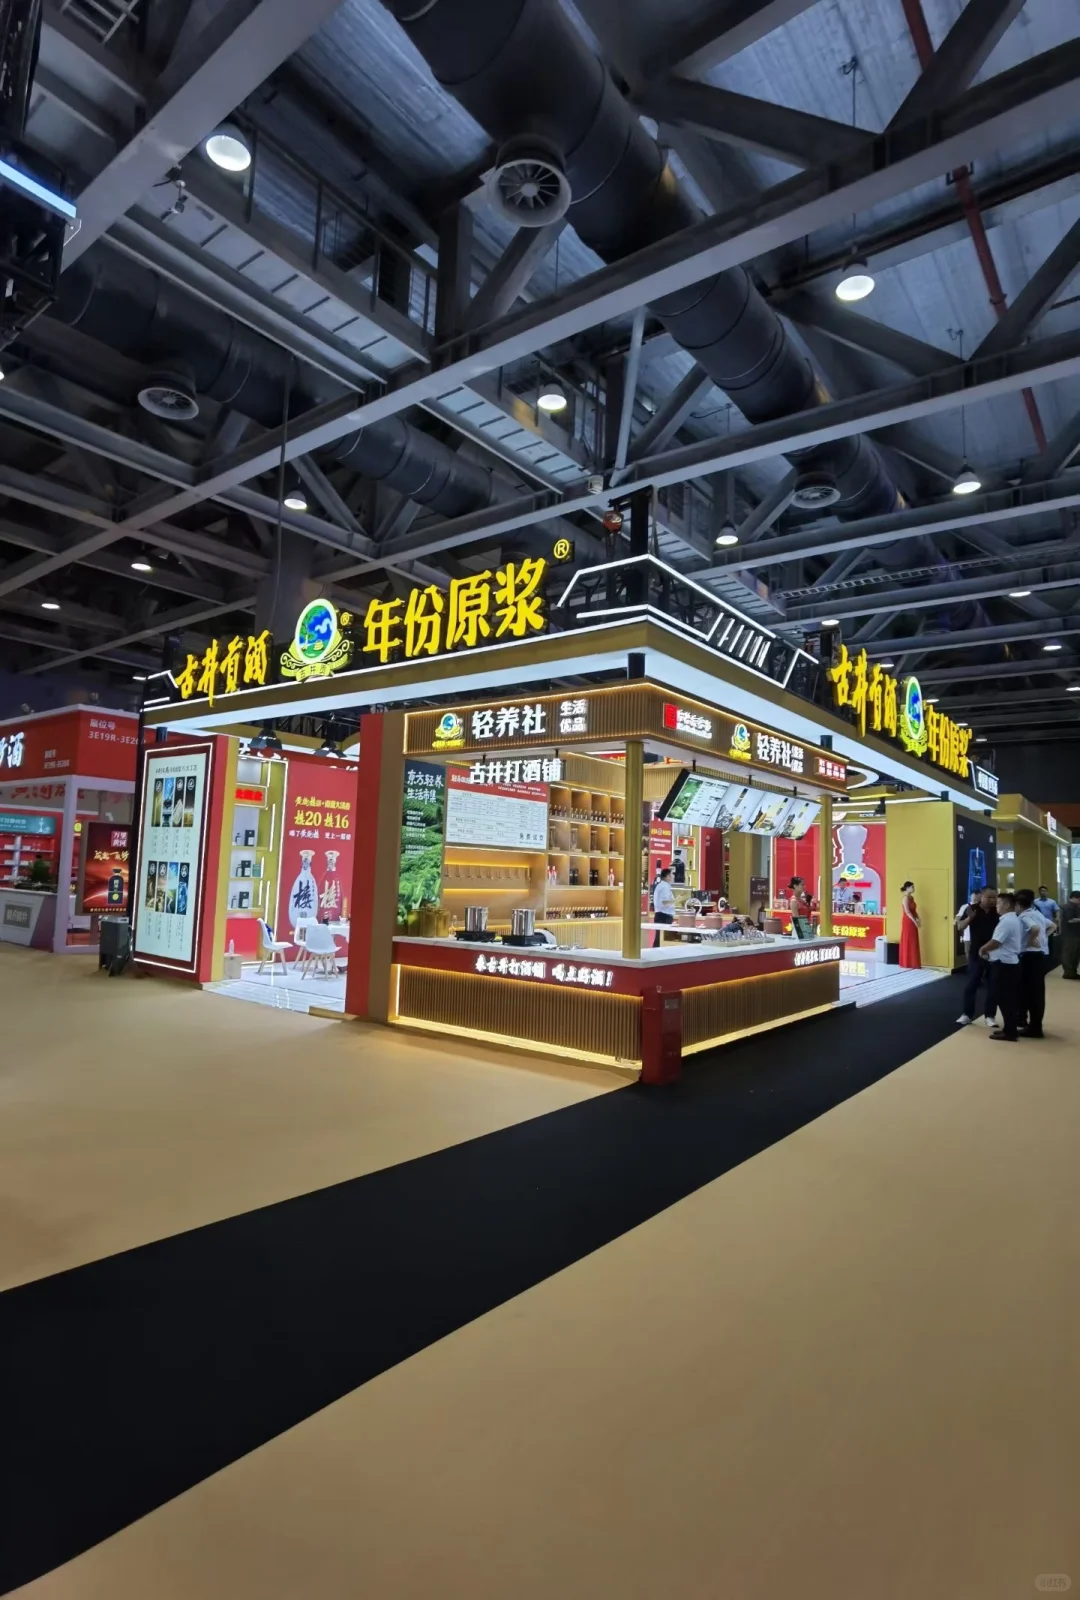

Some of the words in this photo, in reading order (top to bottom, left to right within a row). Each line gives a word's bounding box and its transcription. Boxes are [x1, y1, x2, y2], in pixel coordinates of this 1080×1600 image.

[363, 558, 546, 663] 年份原浆
[472, 704, 547, 739] 轻养社
[560, 698, 587, 716] 生活
[559, 717, 587, 734] 优品
[927, 704, 970, 778] 年份原浆
[757, 732, 792, 768] 轻养社
[470, 758, 562, 784] 古井打酒铺
